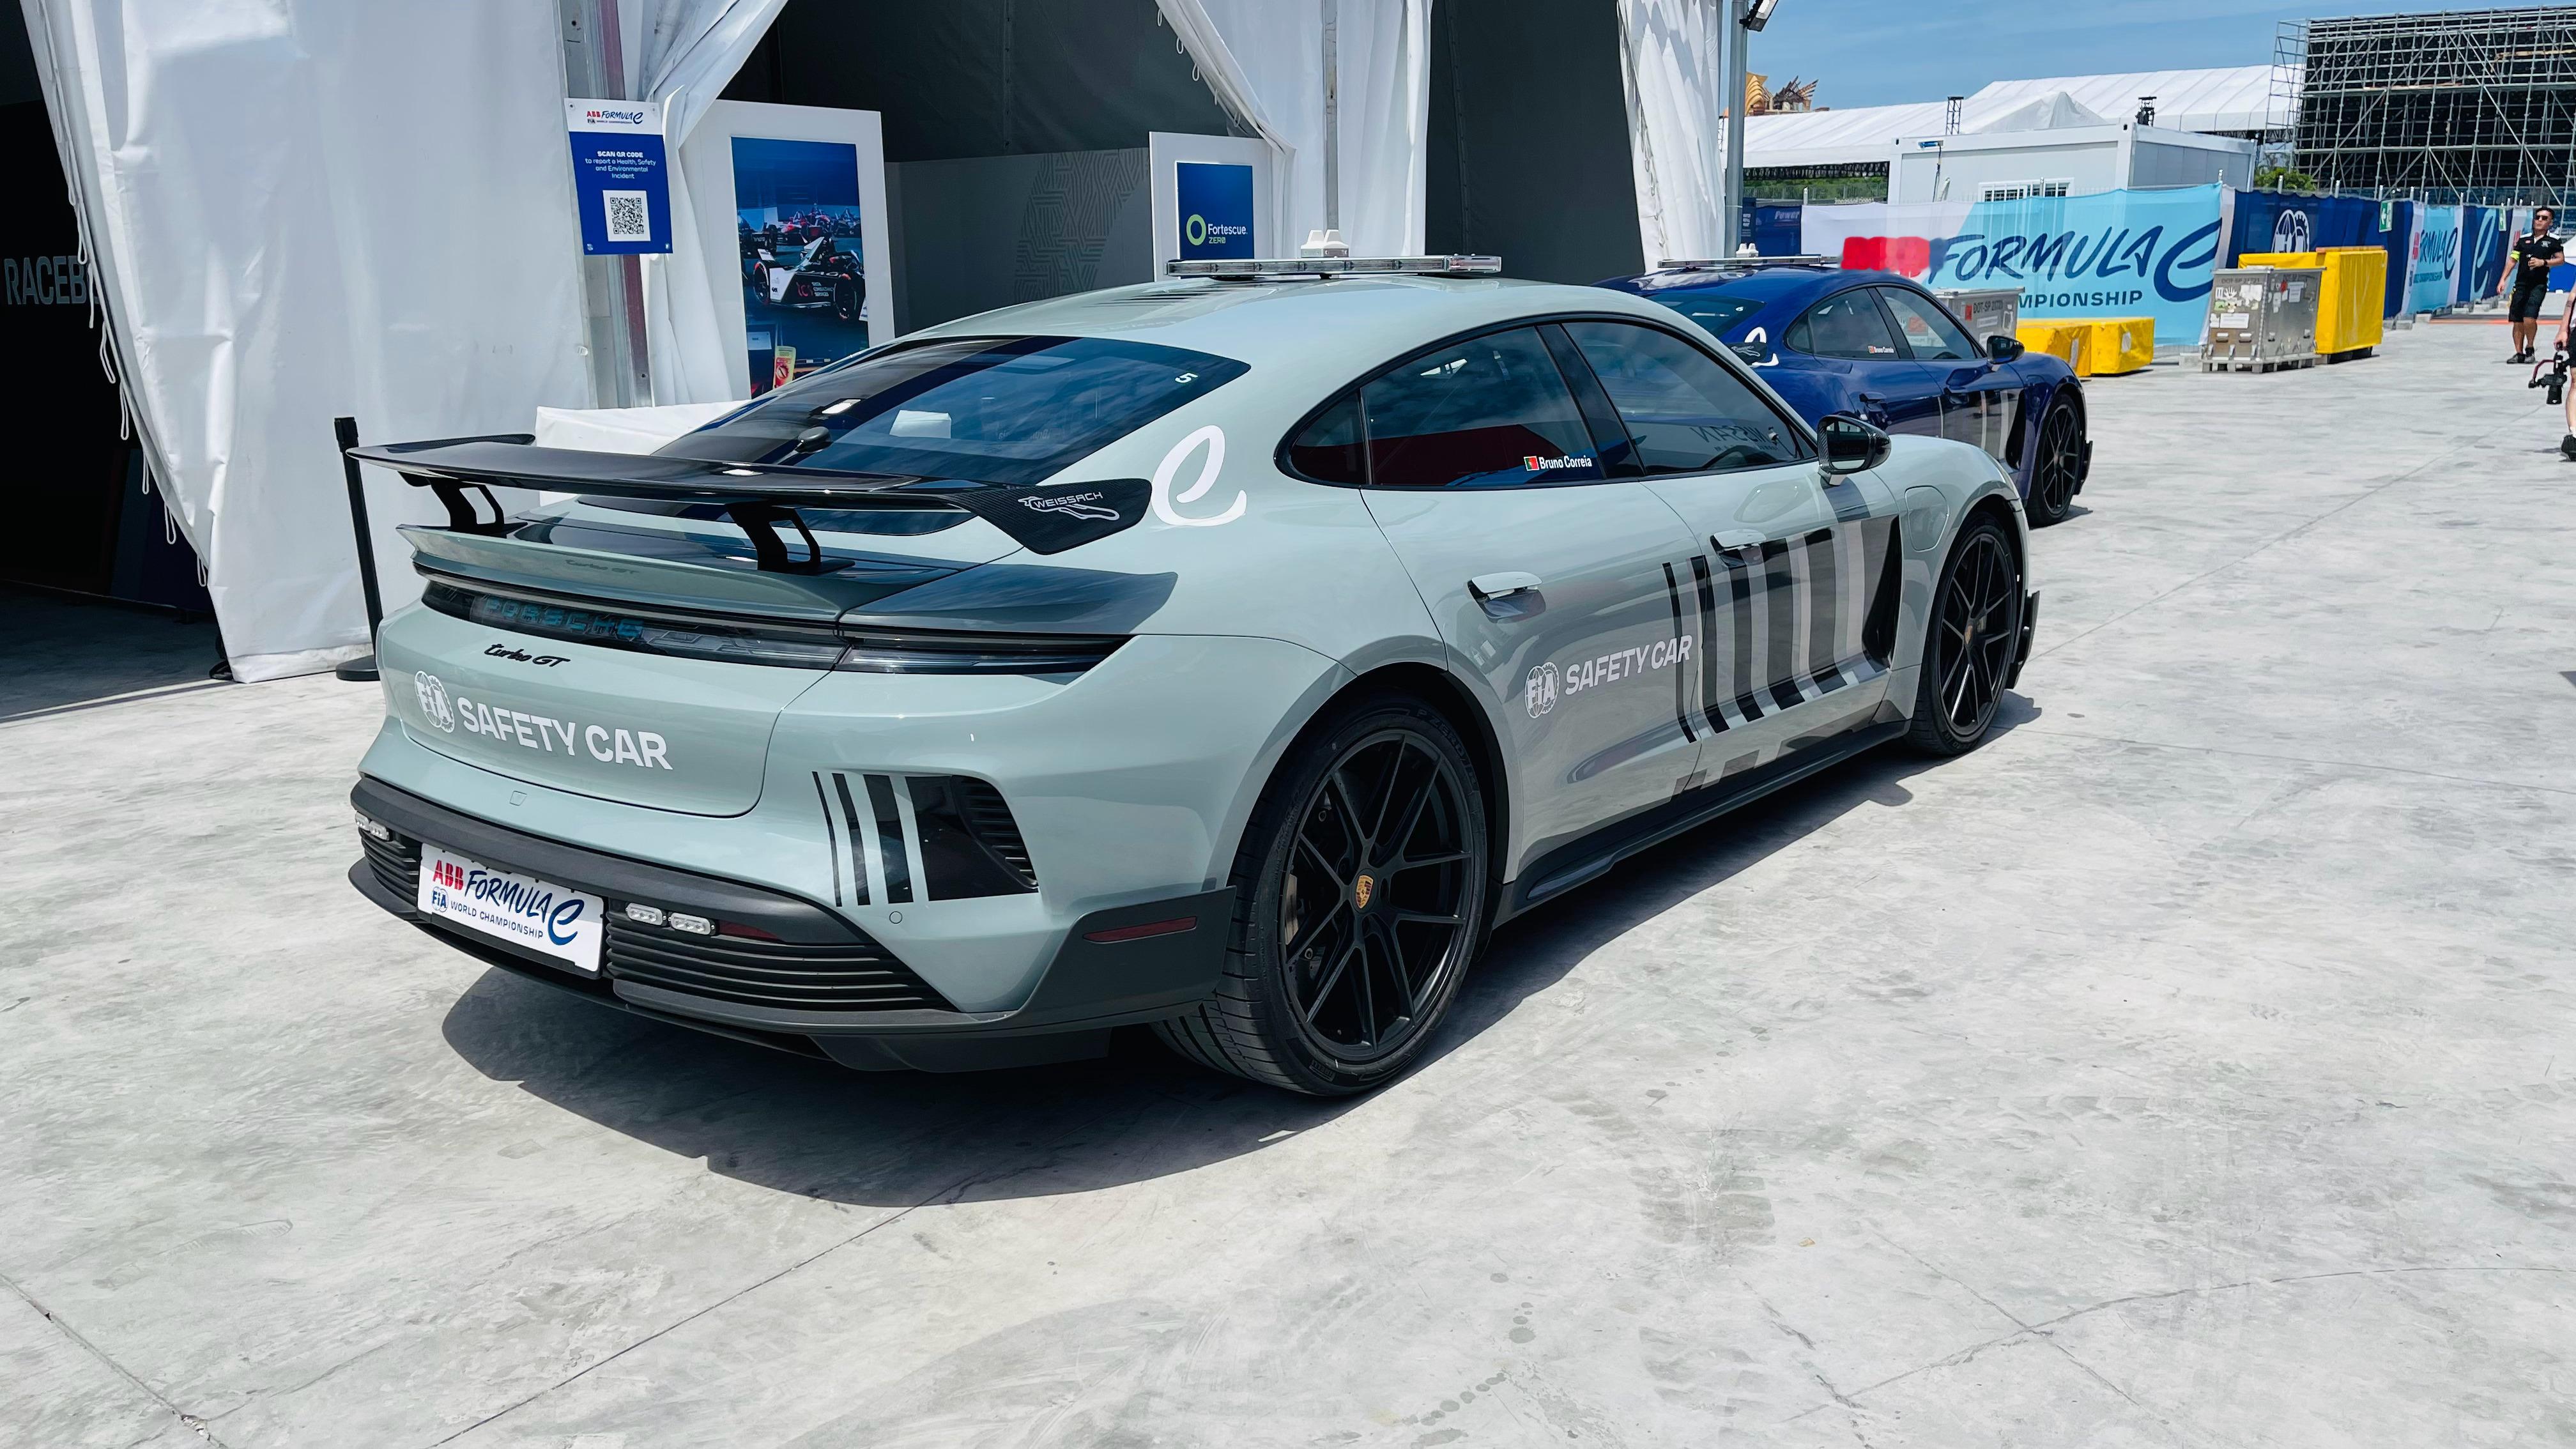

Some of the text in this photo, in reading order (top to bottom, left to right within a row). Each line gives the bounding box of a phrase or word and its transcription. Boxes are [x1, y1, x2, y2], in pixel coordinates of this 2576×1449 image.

[1208, 224, 1247, 235] Fortescue
[4, 256, 98, 305] RACEB
[1174, 372, 1199, 383] 5
[1538, 455, 1592, 470] Bruno Correia
[1034, 491, 1103, 509] WEISSACH
[484, 597, 644, 640] PORSCHE
[532, 655, 571, 668] GT
[1565, 645, 1650, 696] SAFETY
[1650, 634, 1693, 670] CAR
[457, 696, 576, 756] SAFETY
[585, 724, 673, 770] CAR
[433, 859, 464, 891] ABB
[464, 870, 553, 924] FORMULA
[450, 900, 477, 917] WORLD
[479, 910, 544, 939] CHAMPIONSHIP
